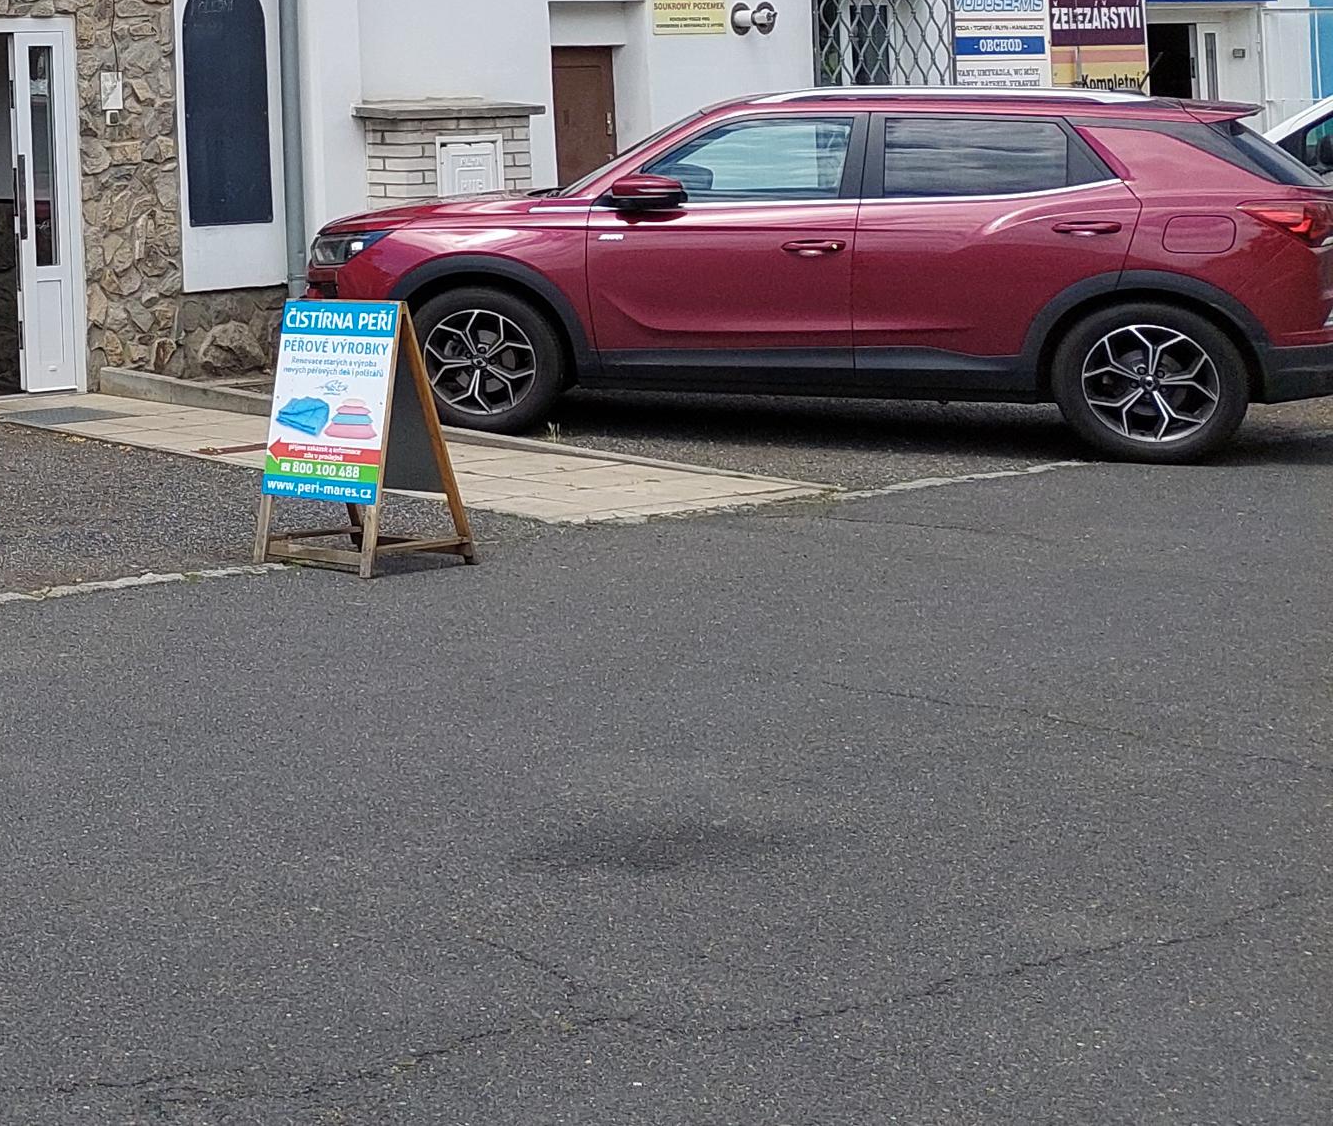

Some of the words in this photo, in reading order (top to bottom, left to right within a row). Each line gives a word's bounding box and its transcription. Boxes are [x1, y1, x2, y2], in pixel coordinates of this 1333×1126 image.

[1052, 0, 1141, 30] ŽELEZÁŘSTVÍ
[286, 308, 353, 330] ČISTÍRNA
[358, 310, 395, 331] PEŘÍ
[284, 337, 329, 353] PÉŘOVÉ
[332, 339, 389, 356] VÝROBKY
[293, 462, 313, 474] 800
[316, 464, 336, 476] 100
[338, 466, 360, 477] 488
[267, 480, 372, 499] www.peri-mares.cz
